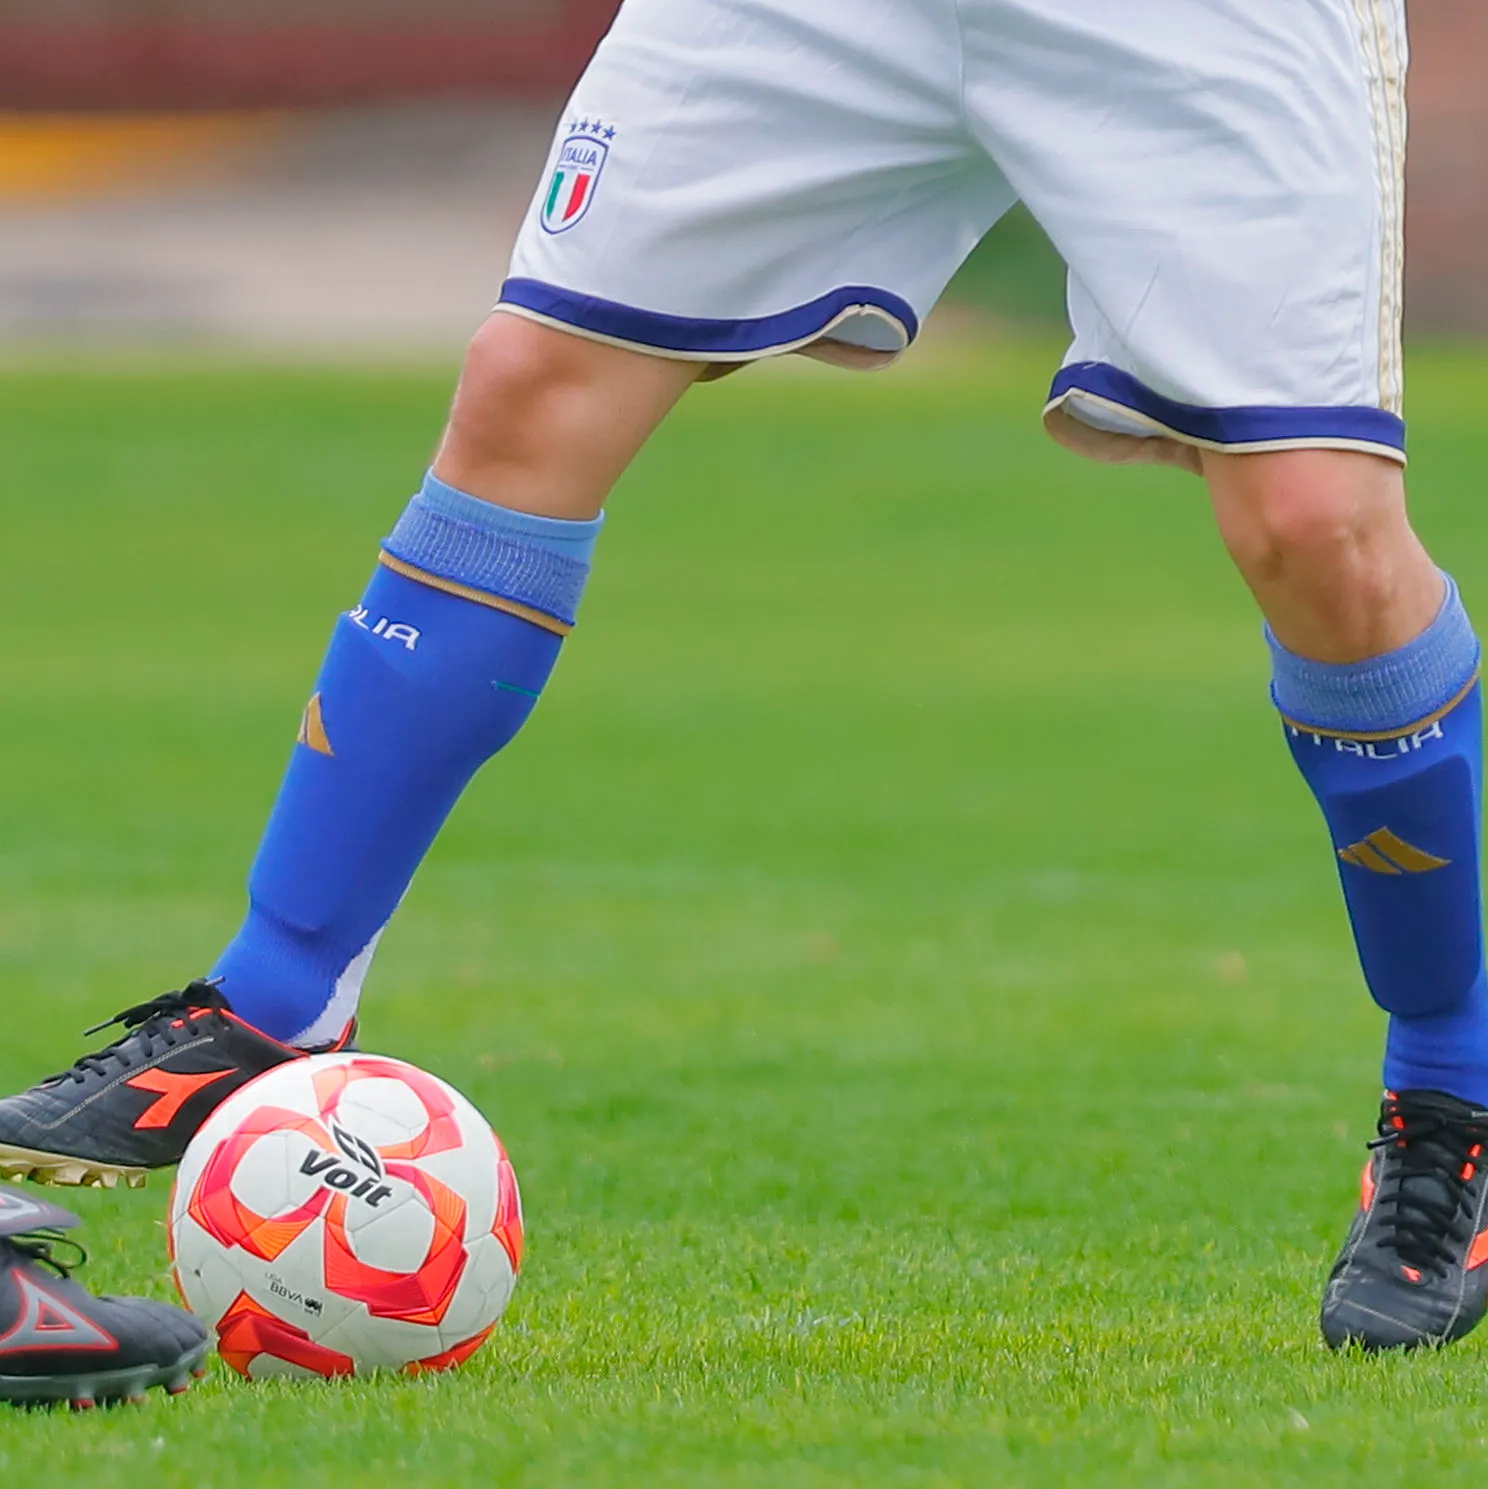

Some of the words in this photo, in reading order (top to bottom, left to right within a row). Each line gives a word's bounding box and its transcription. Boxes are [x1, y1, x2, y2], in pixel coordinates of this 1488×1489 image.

[563, 147, 597, 166] ITALIA
[299, 1148, 393, 1208] Voit
[270, 1281, 303, 1304] BBVA
